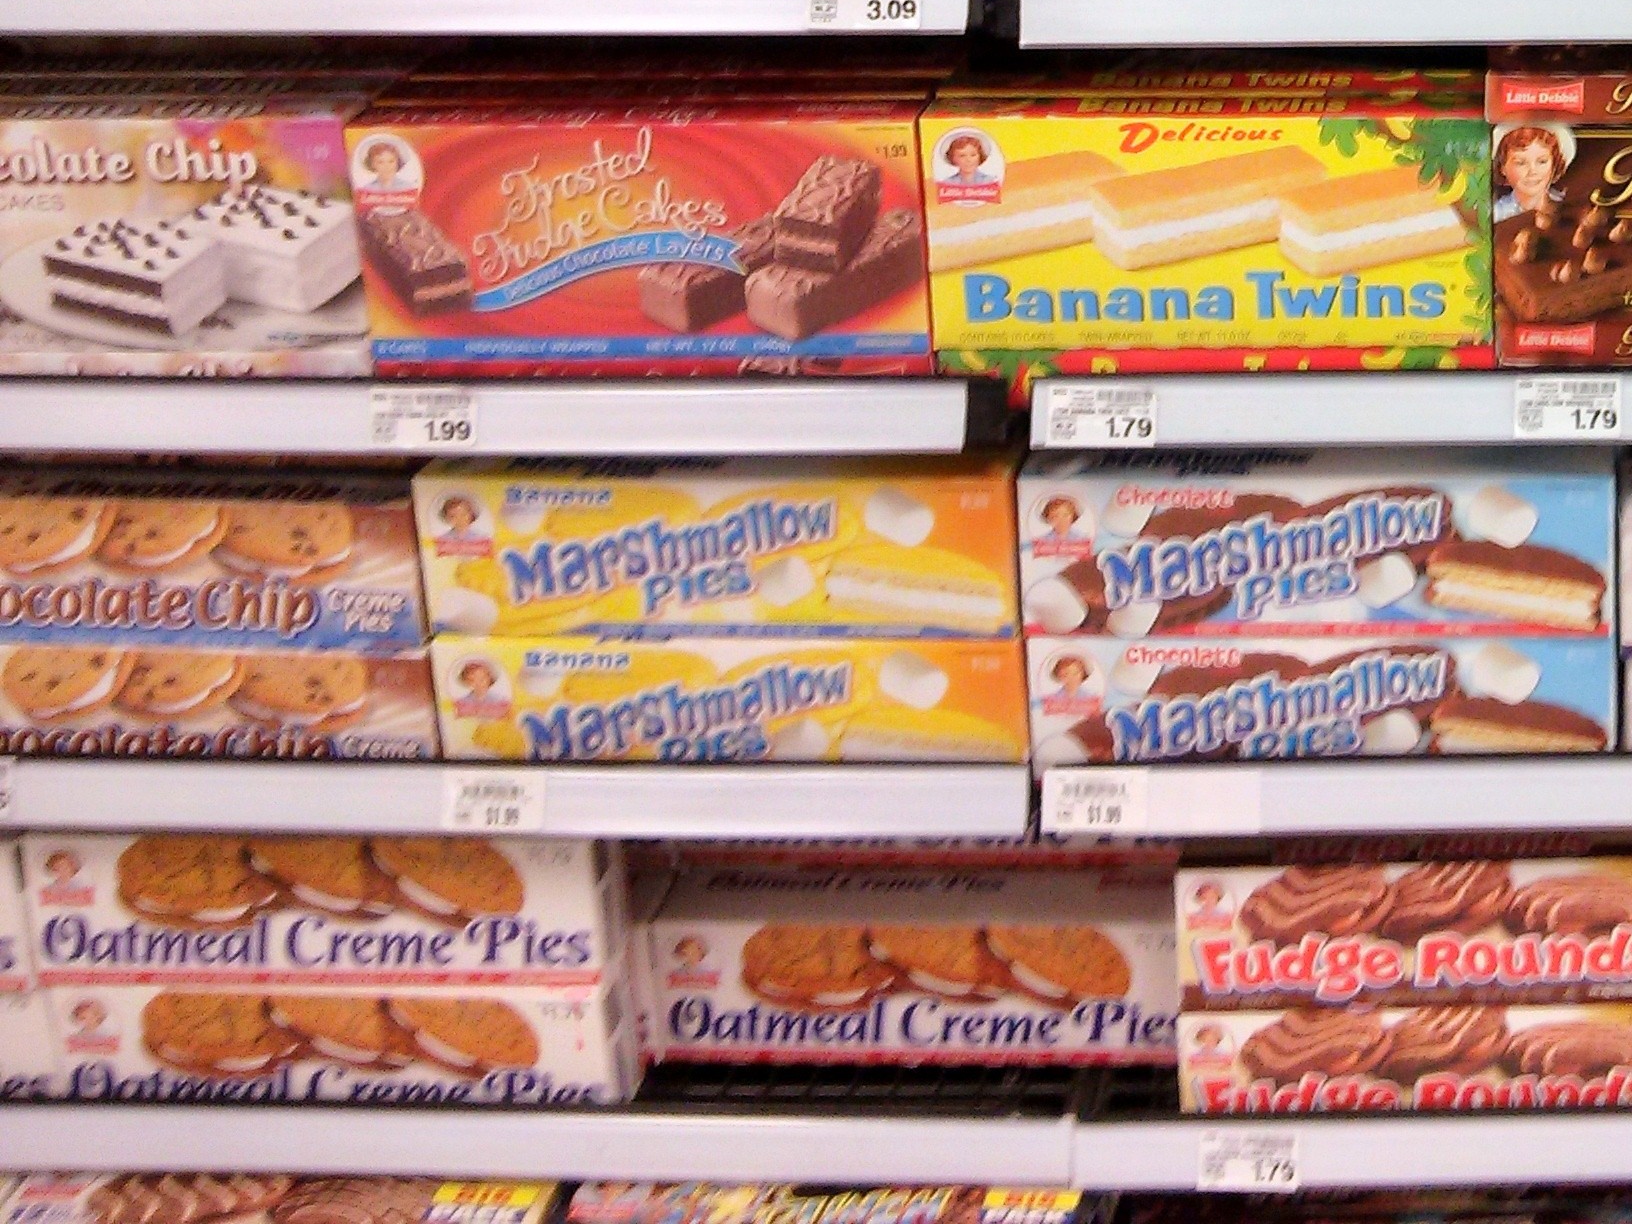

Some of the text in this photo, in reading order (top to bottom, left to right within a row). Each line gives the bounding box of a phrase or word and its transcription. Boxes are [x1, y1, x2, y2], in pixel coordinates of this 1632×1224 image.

[866, 0, 916, 22] 3.09
[1505, 91, 1580, 105] Little Debbie
[1117, 122, 1284, 154] Delicious
[146, 138, 257, 197] Chip
[501, 125, 655, 223] Frosted
[473, 177, 728, 283] Fudge Cakes
[563, 233, 725, 272] Chocolate Layers
[964, 271, 1446, 323] Banana Twins
[426, 421, 471, 442] 1.99
[1104, 418, 1152, 438] 1.79
[1570, 409, 1617, 431] 1.79
[506, 486, 611, 507] Banana
[1116, 486, 1235, 511] Chocolate
[501, 498, 837, 605] Marshmallow
[1098, 492, 1447, 612] Marshmallow
[195, 578, 320, 638] Chip
[326, 586, 407, 612] Creme
[345, 610, 394, 633] Pies
[524, 650, 631, 670] Banana
[1126, 645, 1242, 667] Chocolate
[519, 663, 853, 761] Marshmallow
[1106, 648, 1452, 760] Marshmallow
[41, 914, 592, 968] Oatmeal Creme Pies
[1197, 929, 1403, 1002] Fudge
[669, 995, 1060, 1047] Oatmeal Creme
